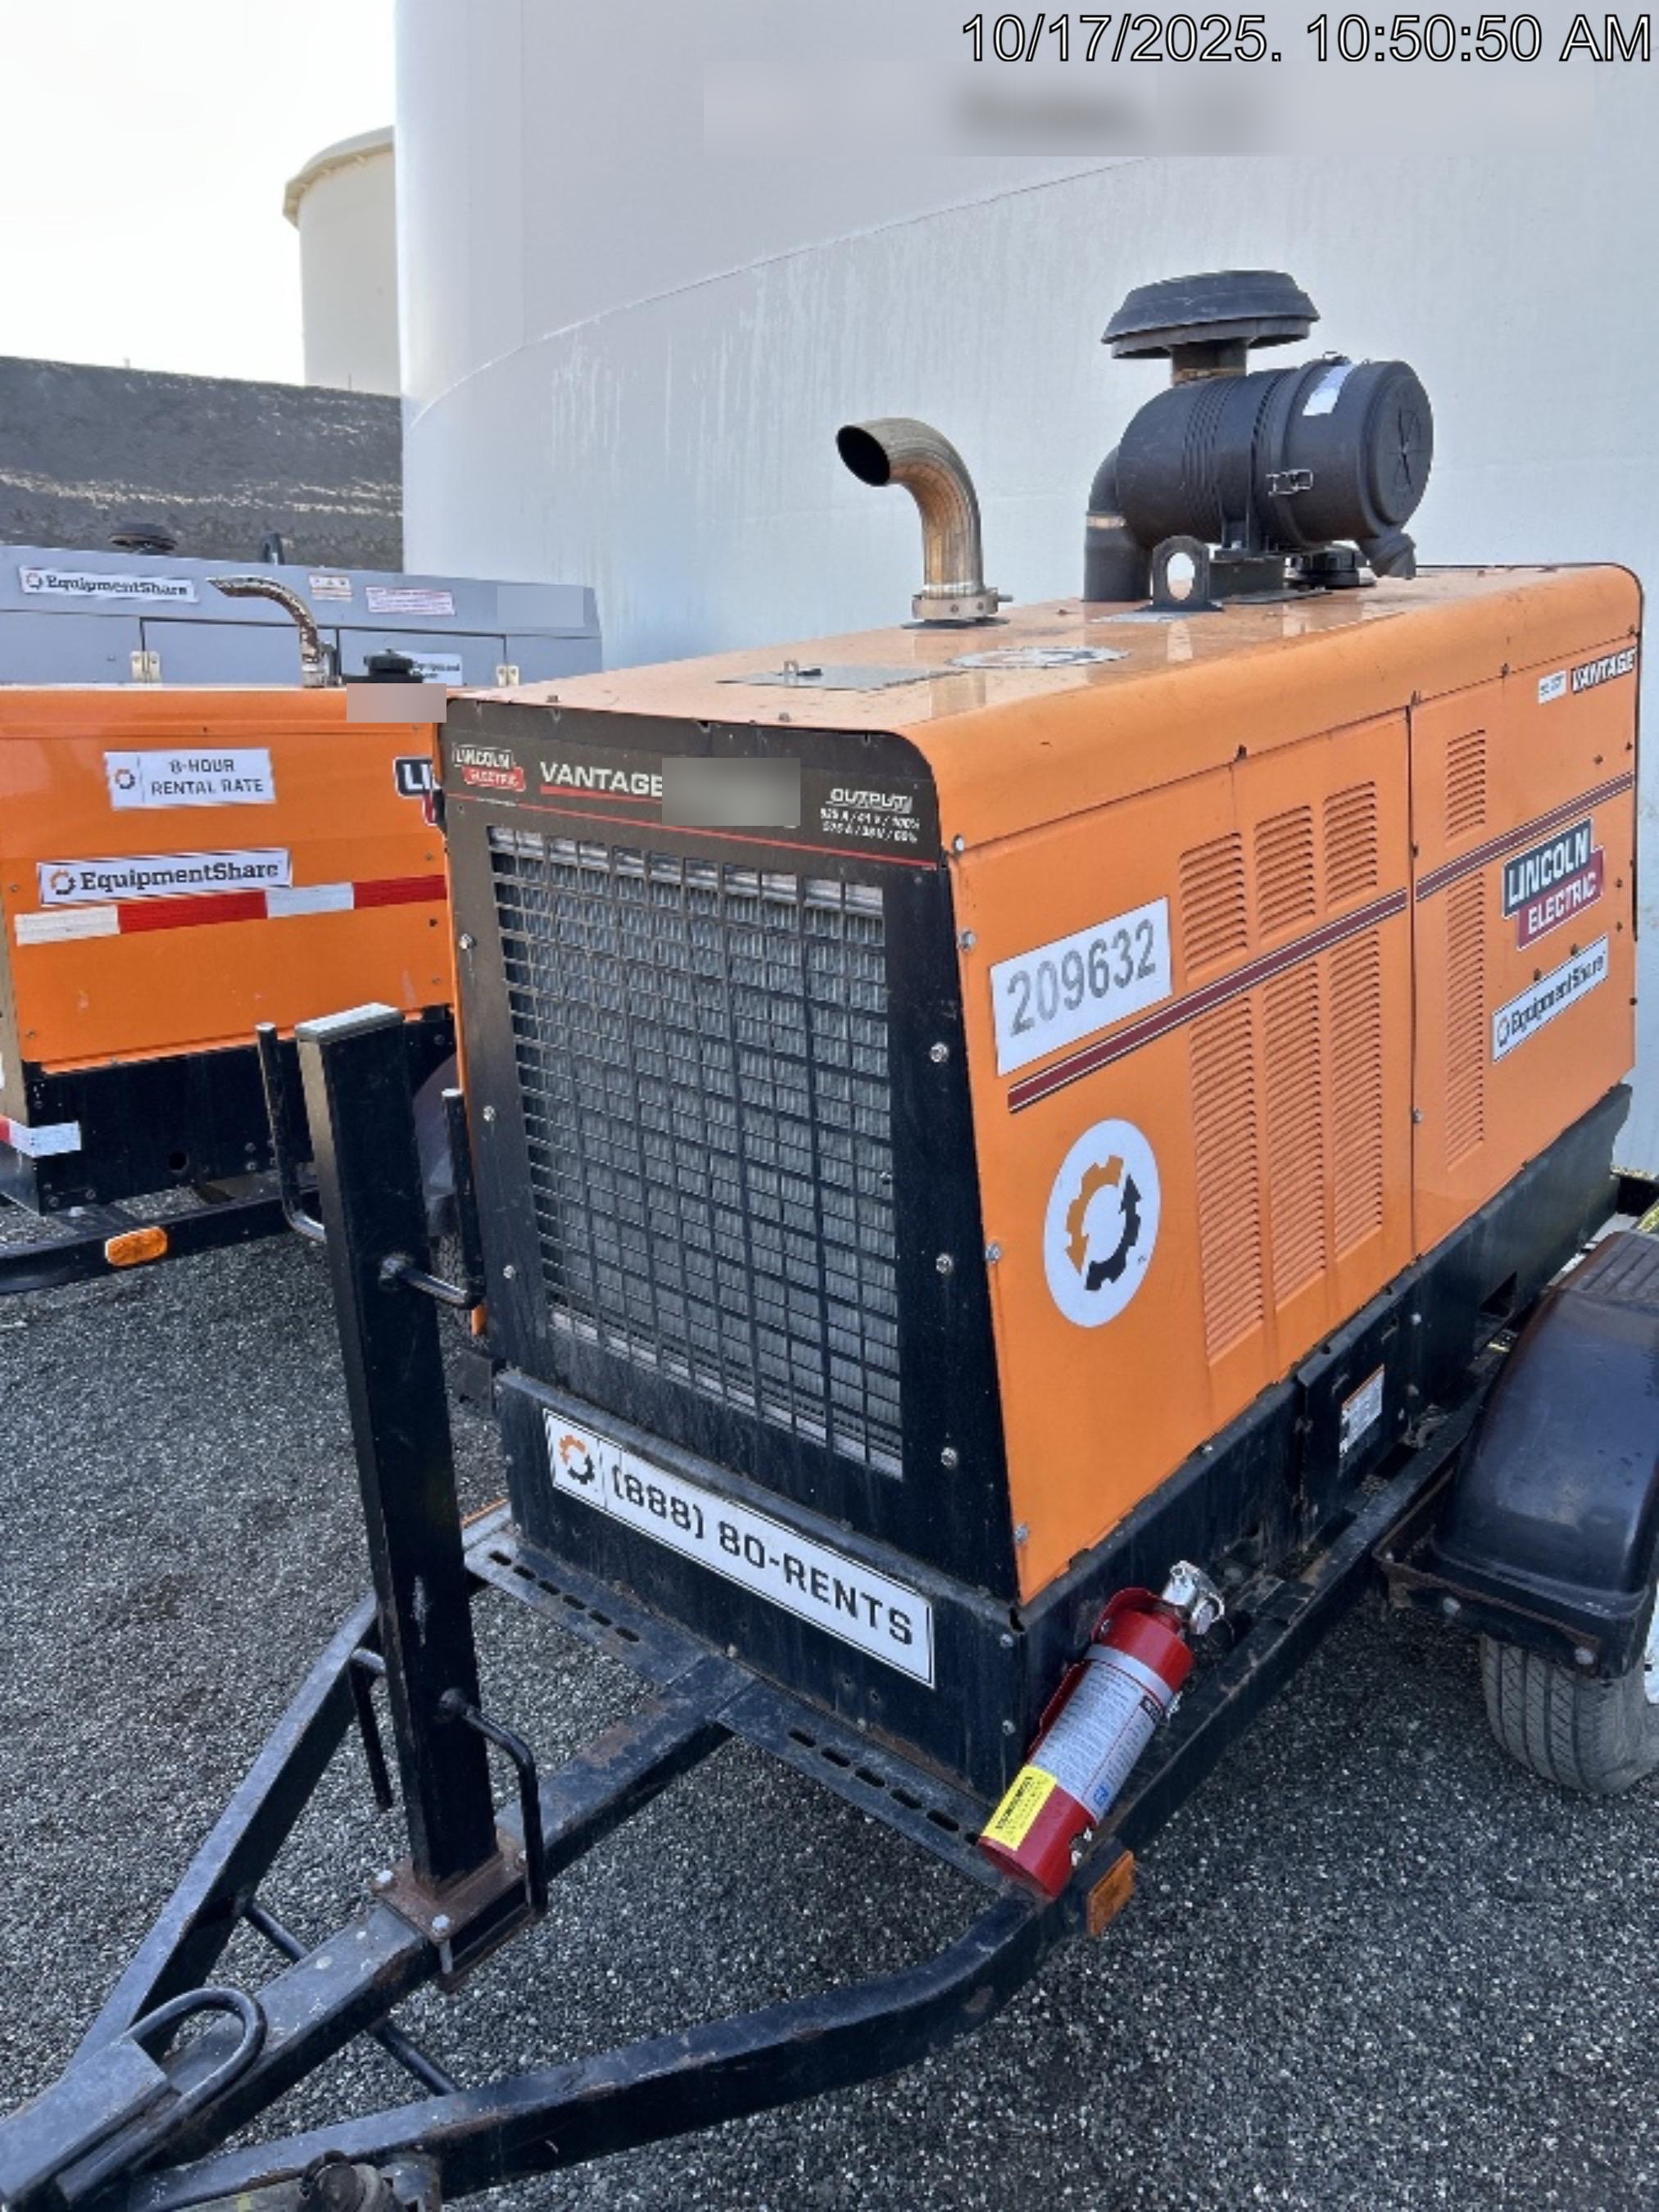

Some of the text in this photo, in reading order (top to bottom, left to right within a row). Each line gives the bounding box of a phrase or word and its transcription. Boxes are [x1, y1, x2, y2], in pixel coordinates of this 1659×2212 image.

[1571, 646, 1638, 694] VANTAGE
[170, 759, 234, 773] 8-HOUR
[456, 749, 512, 768] LINCOLN
[152, 779, 263, 796] RENTAL RATE
[539, 761, 663, 797] VANTAGE
[829, 787, 911, 811] OUTPUT
[80, 862, 279, 892] EquipmentShare
[1508, 827, 1589, 907] LINCOLN
[1527, 872, 1597, 935] ELECTRIC
[1007, 918, 1156, 1037] 209632
[611, 1463, 913, 1645] (888) 80-RENTS
